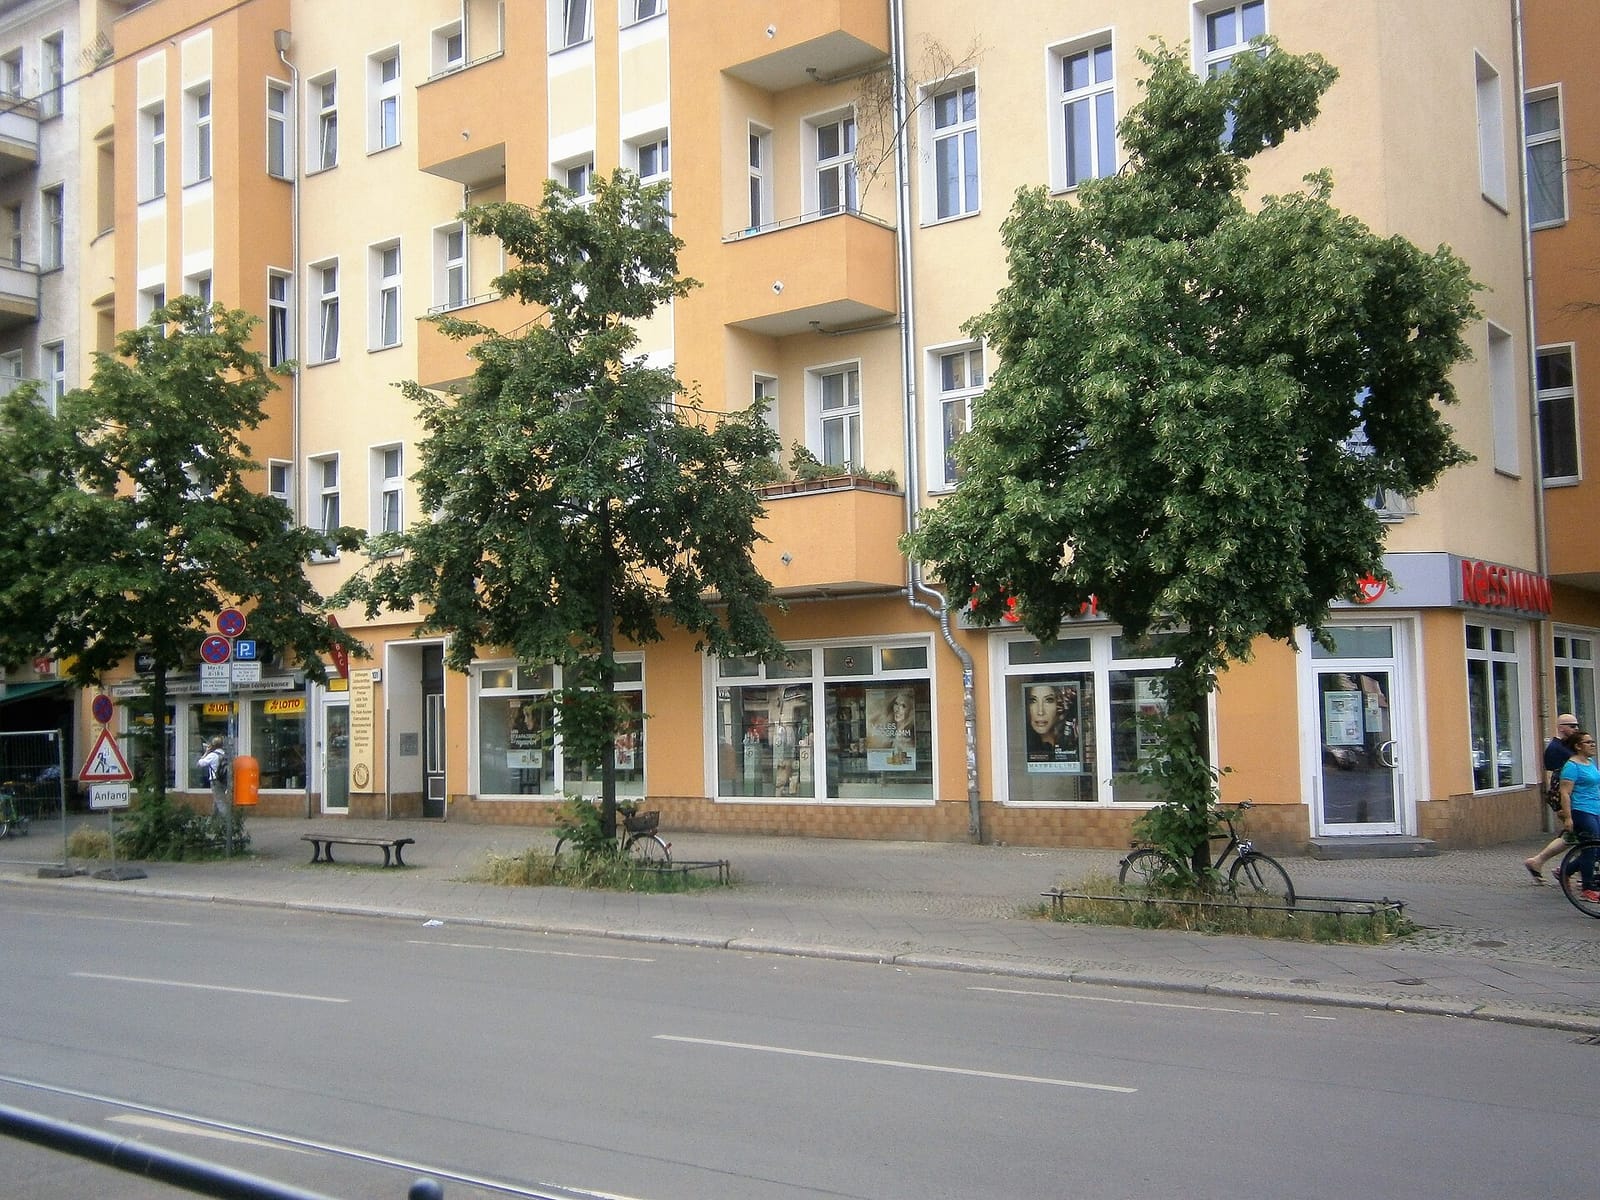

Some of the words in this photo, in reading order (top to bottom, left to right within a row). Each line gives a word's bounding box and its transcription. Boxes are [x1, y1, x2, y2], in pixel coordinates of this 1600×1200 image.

[1461, 559, 1553, 614] ROSSMANN
[280, 699, 300, 709] LOTTO
[95, 791, 127, 801] Anfang
